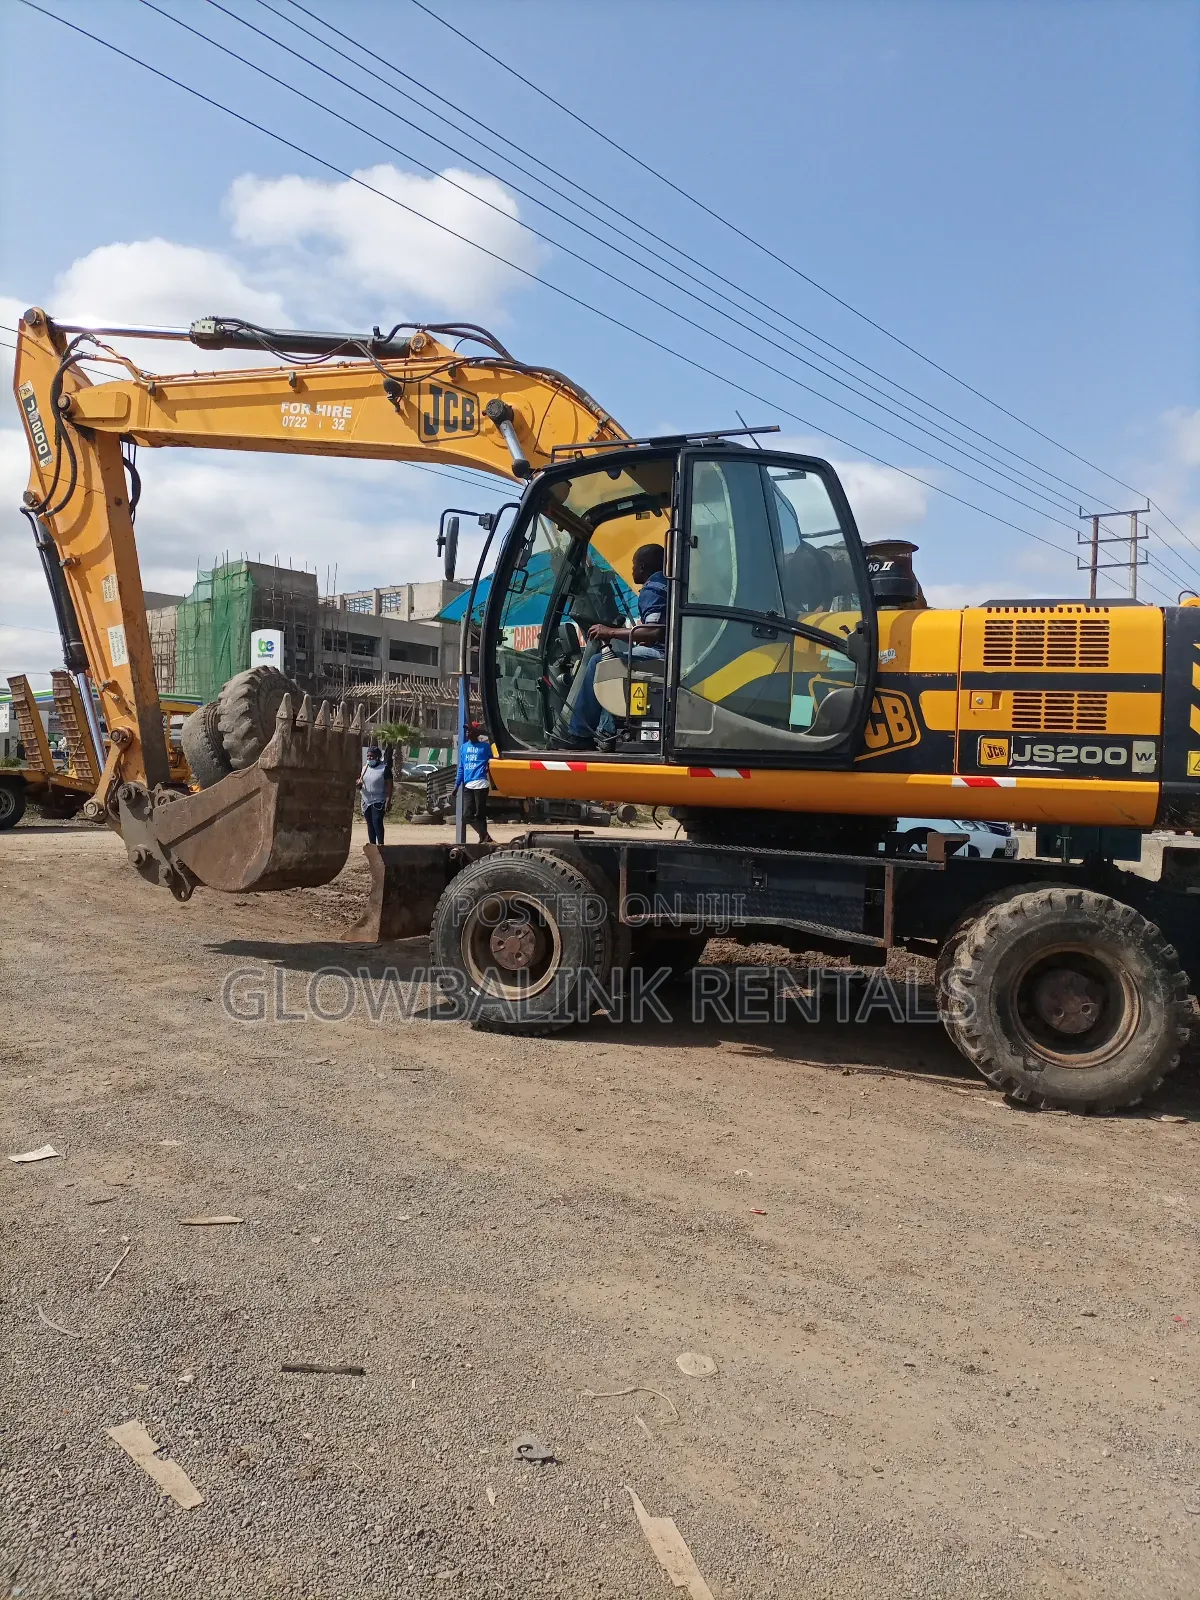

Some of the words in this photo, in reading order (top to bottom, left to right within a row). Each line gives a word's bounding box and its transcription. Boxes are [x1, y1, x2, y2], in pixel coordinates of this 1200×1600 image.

[281, 402, 311, 415] FOR
[315, 404, 352, 418] HIRE
[424, 384, 475, 436] JCB
[282, 416, 307, 428] 0722
[864, 695, 912, 749] CB
[987, 745, 1005, 759] JCB
[1012, 744, 1128, 765] JS200
